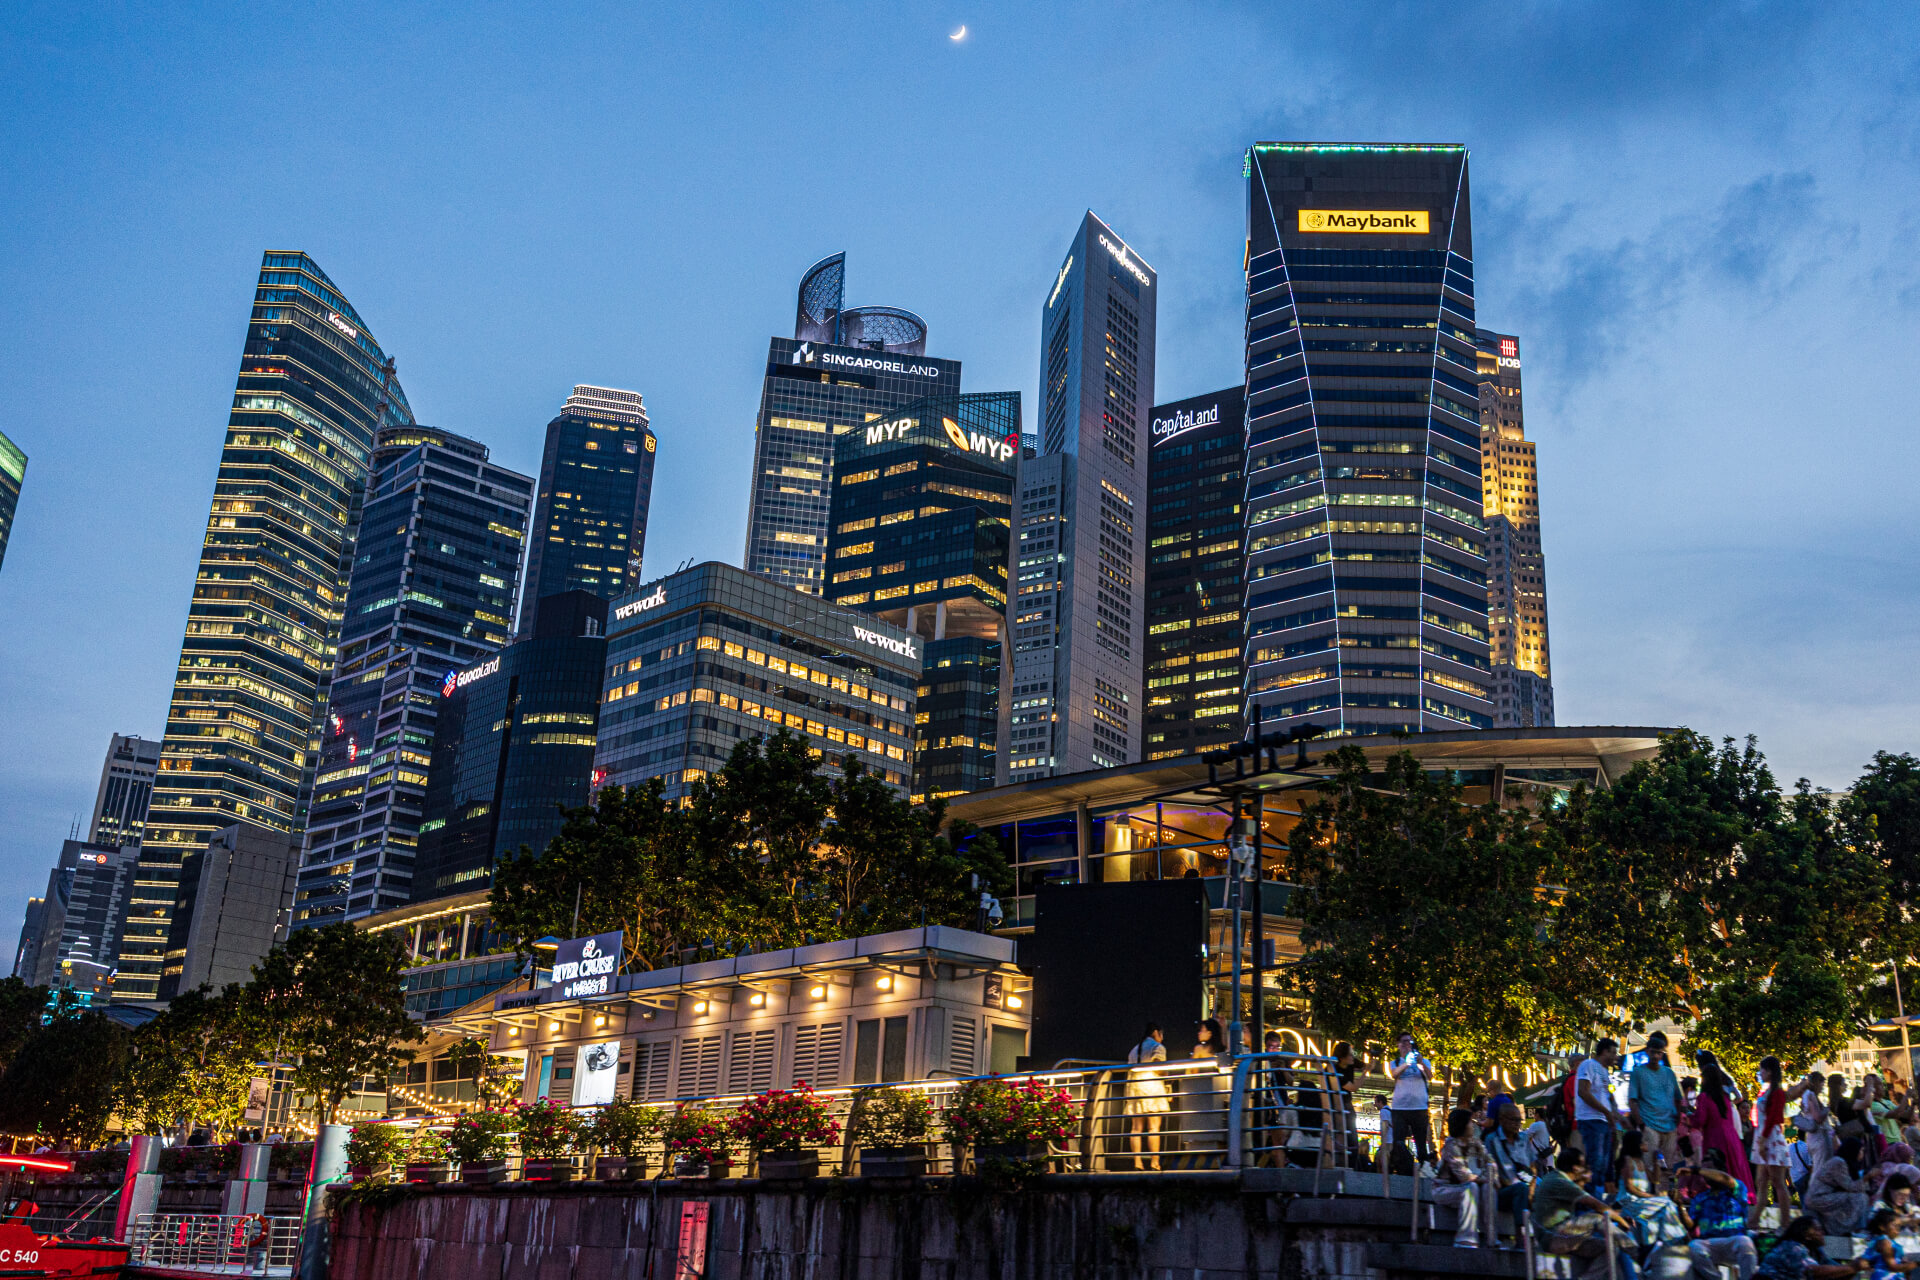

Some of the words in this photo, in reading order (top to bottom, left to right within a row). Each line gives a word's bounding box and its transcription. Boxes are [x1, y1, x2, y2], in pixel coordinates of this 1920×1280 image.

[1327, 213, 1417, 231] Maybank
[328, 312, 357, 339] Keppel
[822, 353, 939, 377] SINGAPORELAND
[1498, 356, 1521, 369] UOB
[866, 418, 913, 450] MYP
[1153, 403, 1218, 436] CapitaLand
[970, 431, 1014, 462] MYP
[614, 585, 667, 621] wework
[852, 625, 917, 660] wework
[457, 655, 500, 687] GuocoLand
[579, 955, 615, 977] CRUISE
[13, 1250, 39, 1264] 540
